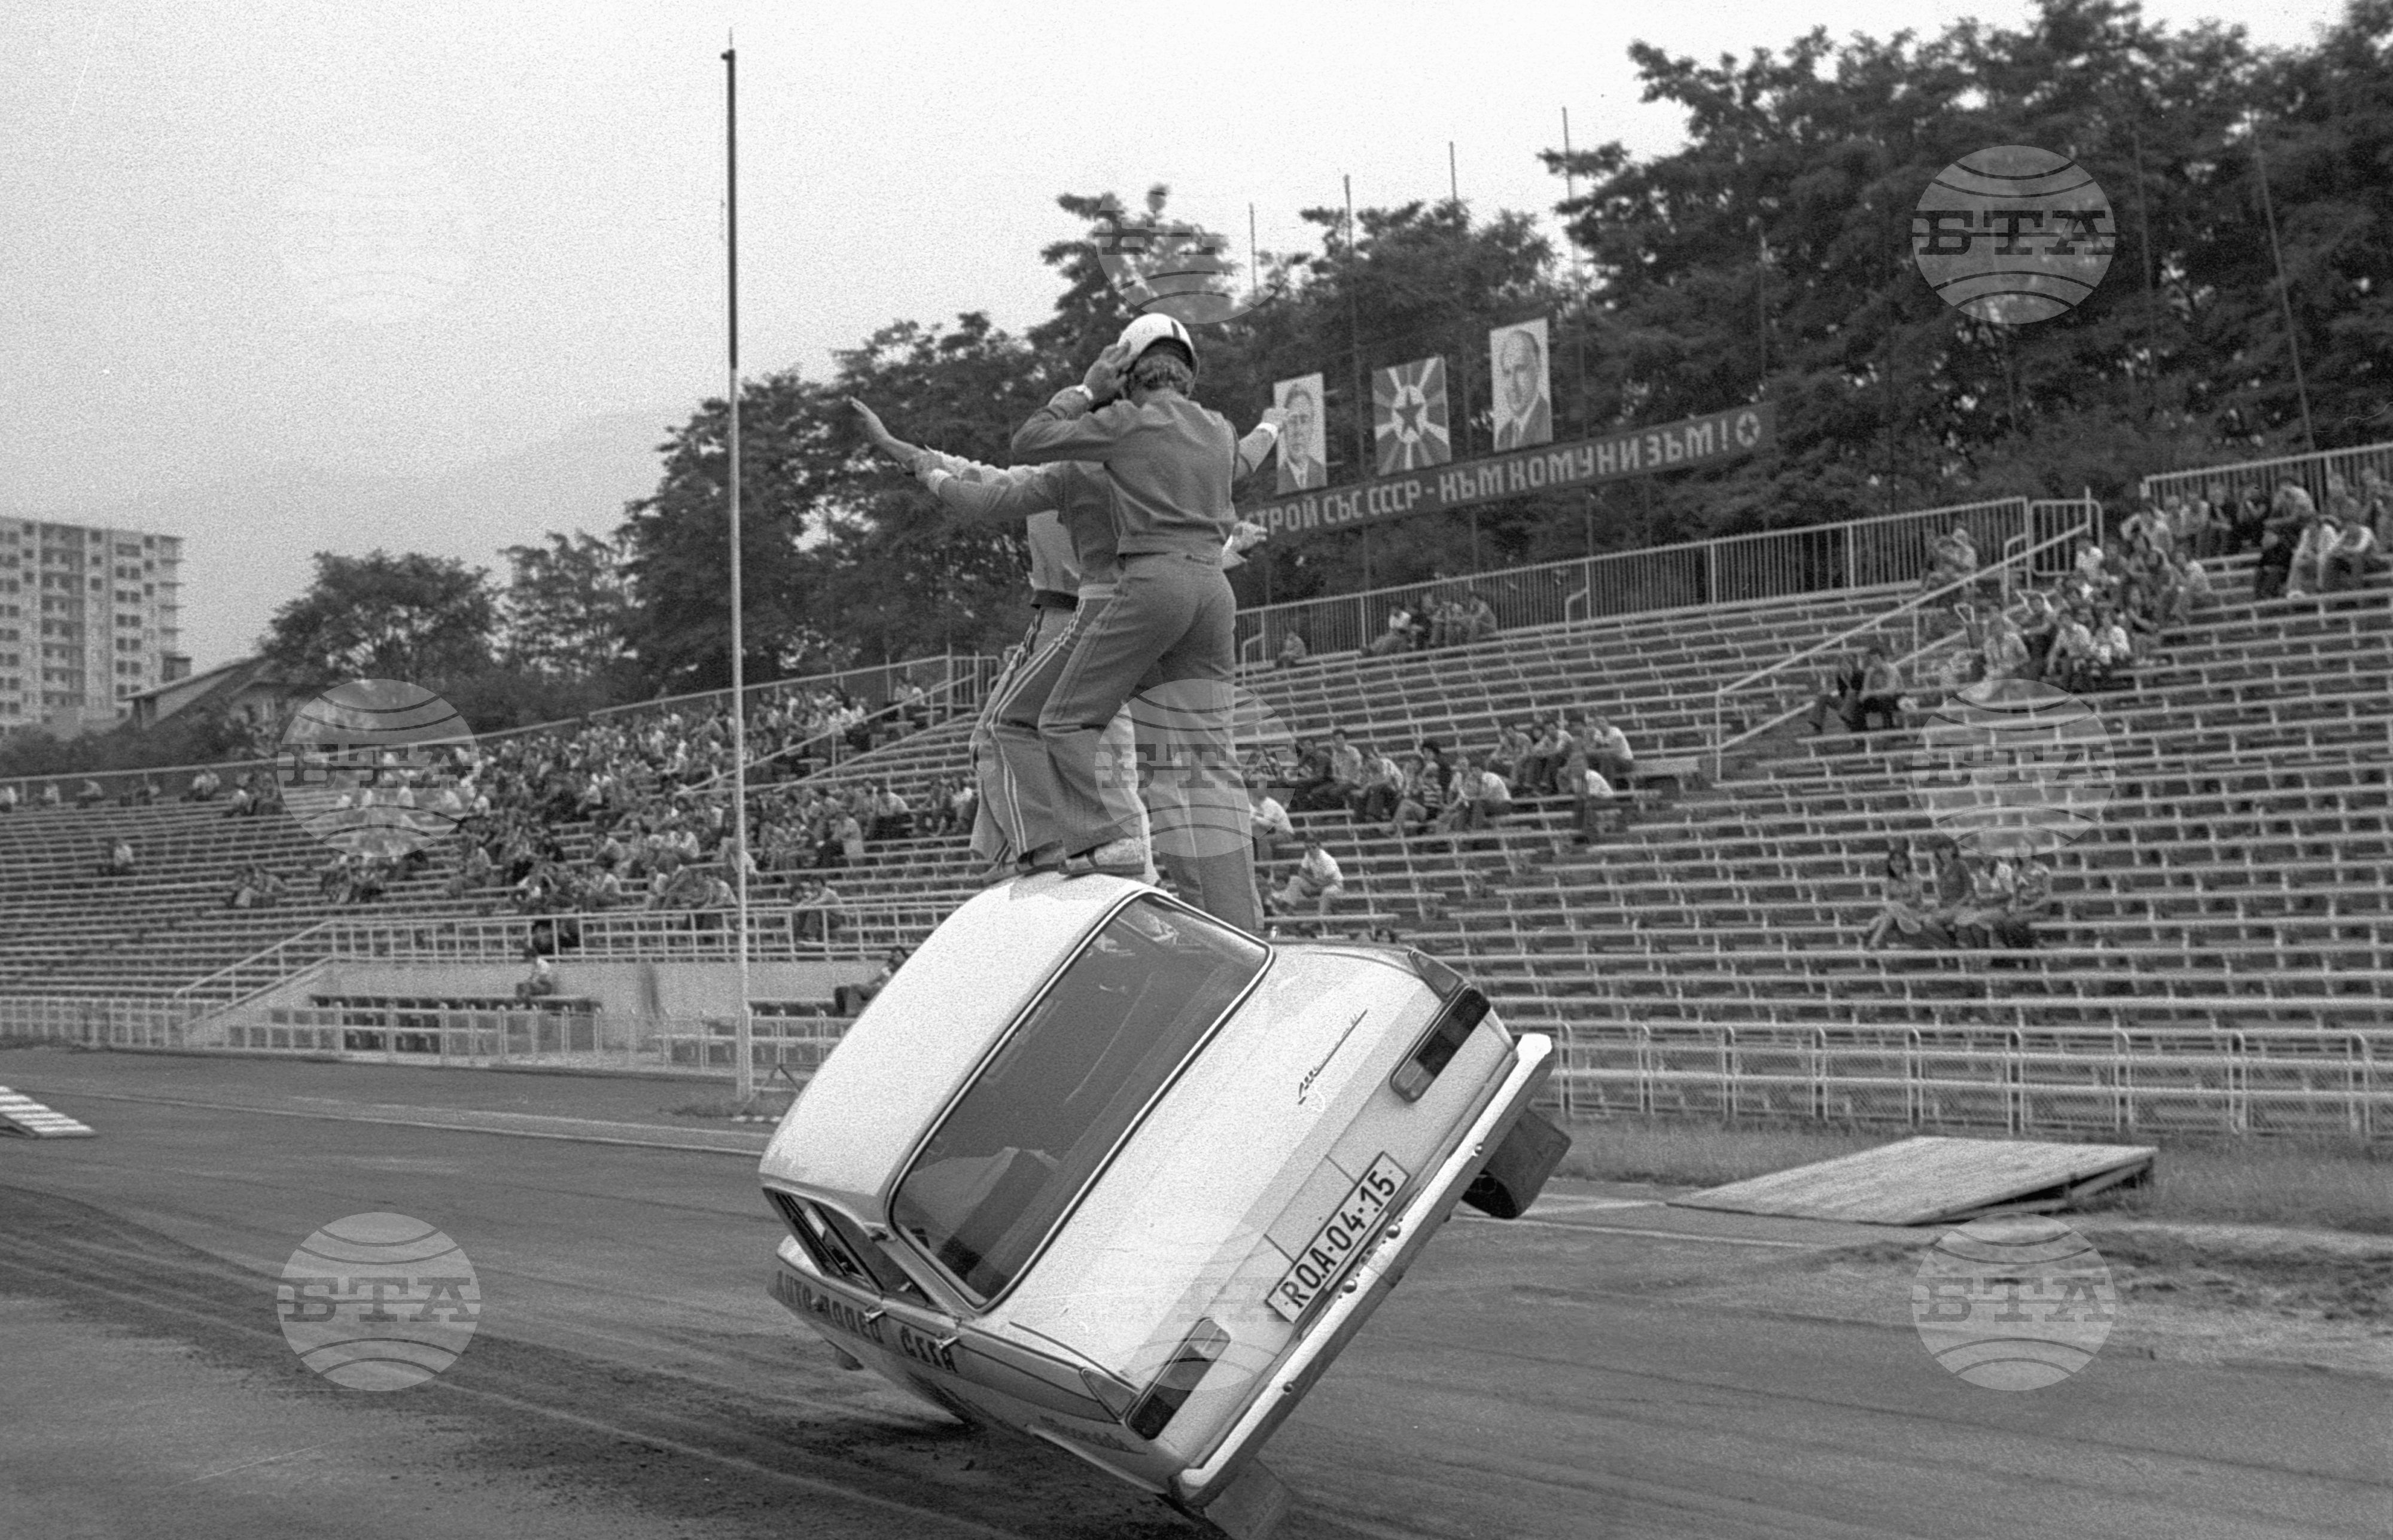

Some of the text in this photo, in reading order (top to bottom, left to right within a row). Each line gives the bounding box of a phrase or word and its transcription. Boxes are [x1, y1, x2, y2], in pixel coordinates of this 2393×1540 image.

[1323, 490, 1363, 524] СЪС
[1368, 479, 1421, 515] СССР
[1439, 464, 1505, 504] КЪМ
